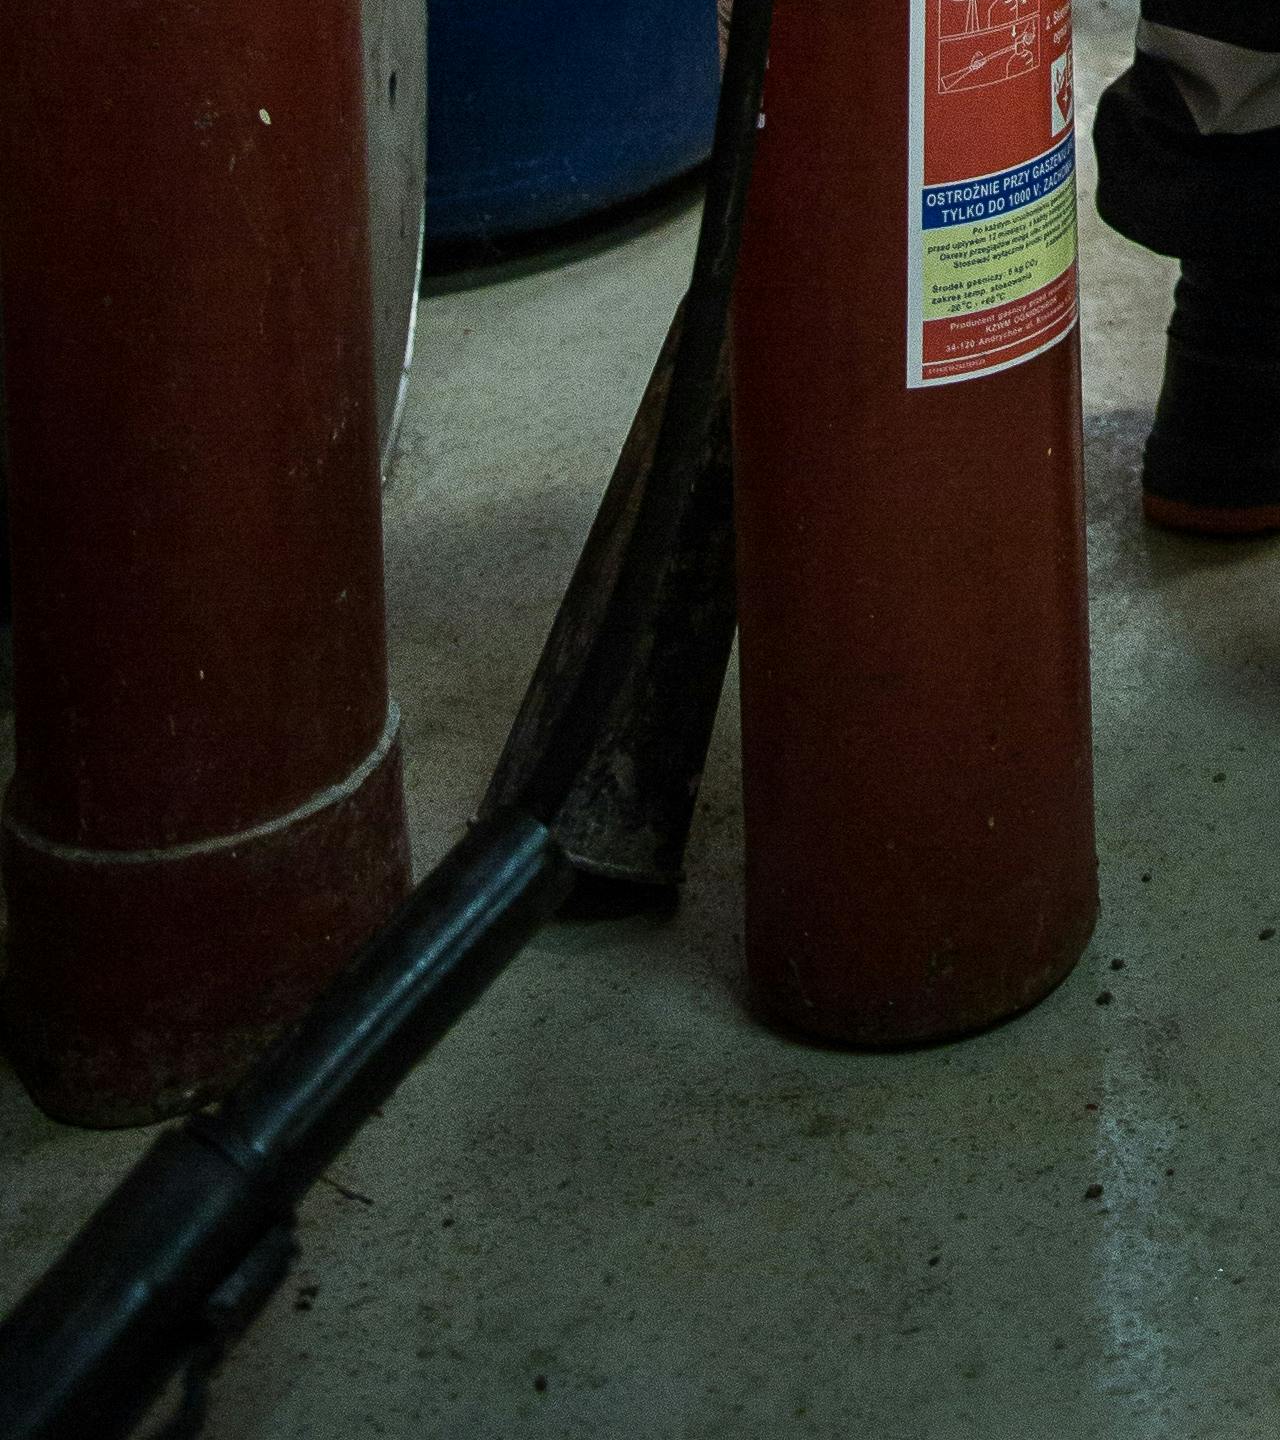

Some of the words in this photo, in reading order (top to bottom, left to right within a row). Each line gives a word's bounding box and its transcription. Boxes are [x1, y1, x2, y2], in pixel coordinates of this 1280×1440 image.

[926, 180, 999, 206] OSTROŻNIE
[1003, 170, 1029, 190] PRZY
[942, 203, 984, 222] TYLKO
[988, 198, 1004, 213] DO
[1009, 188, 1030, 207] 1000
[932, 281, 963, 293] Środek
[931, 293, 960, 304] zakres
[949, 315, 994, 330] Producent
